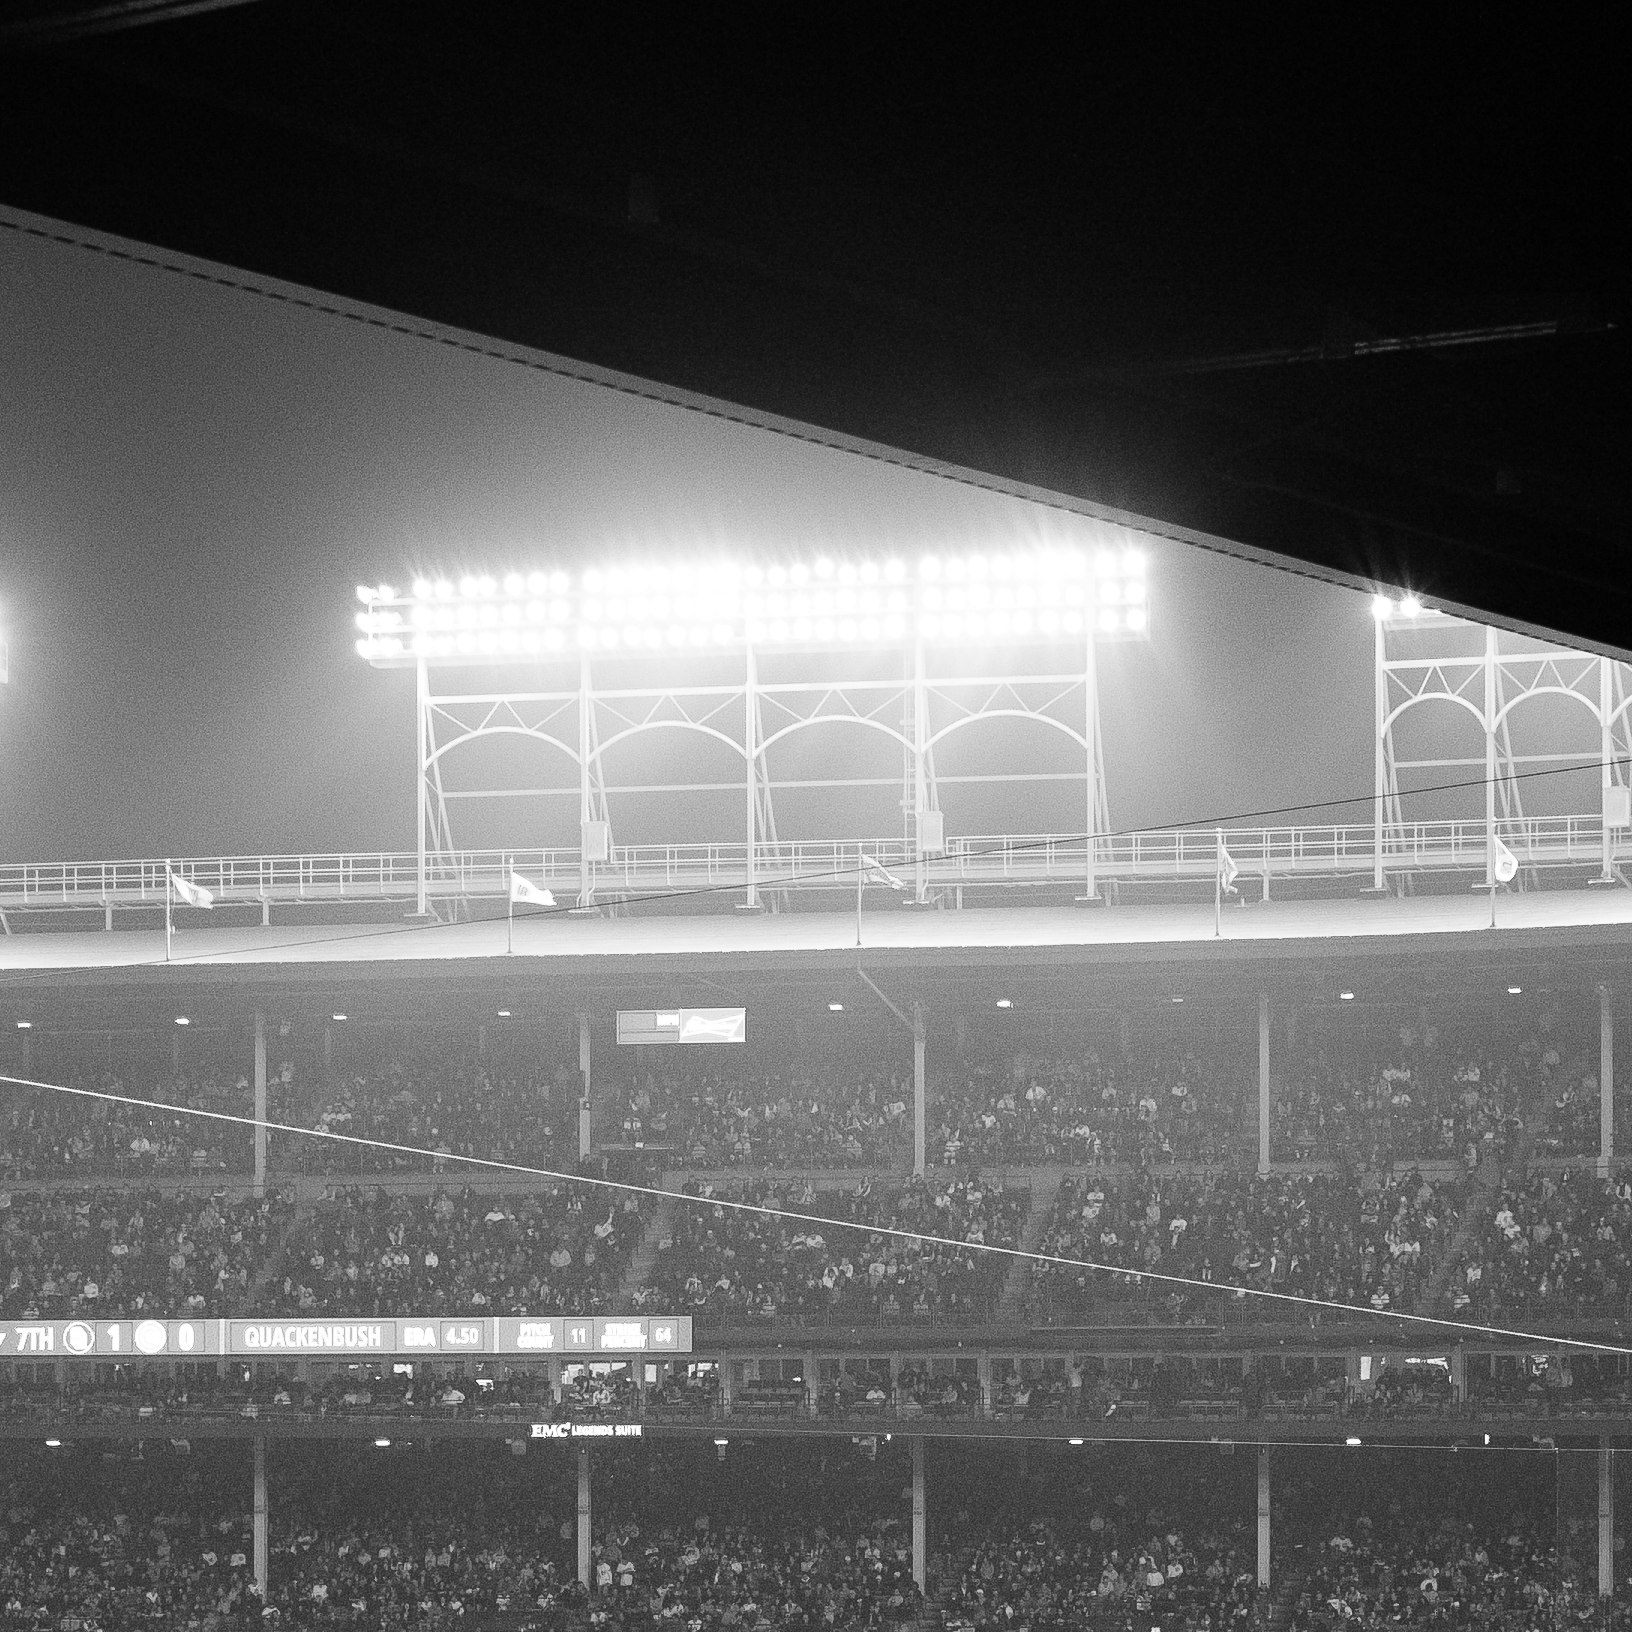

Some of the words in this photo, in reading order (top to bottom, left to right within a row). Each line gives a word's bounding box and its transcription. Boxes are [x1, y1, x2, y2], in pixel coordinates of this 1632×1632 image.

[14, 1325, 55, 1352] 7TH
[107, 1324, 121, 1351] 1
[177, 1323, 195, 1351] 0
[244, 1326, 382, 1348] QUACKENBUSH
[404, 1327, 436, 1348] ERA
[446, 1328, 479, 1346] 4.50
[571, 1327, 586, 1343] 11
[655, 1327, 672, 1343] 64
[571, 1424, 614, 1436] LEGENDS
[614, 1424, 643, 1436] SUITE
